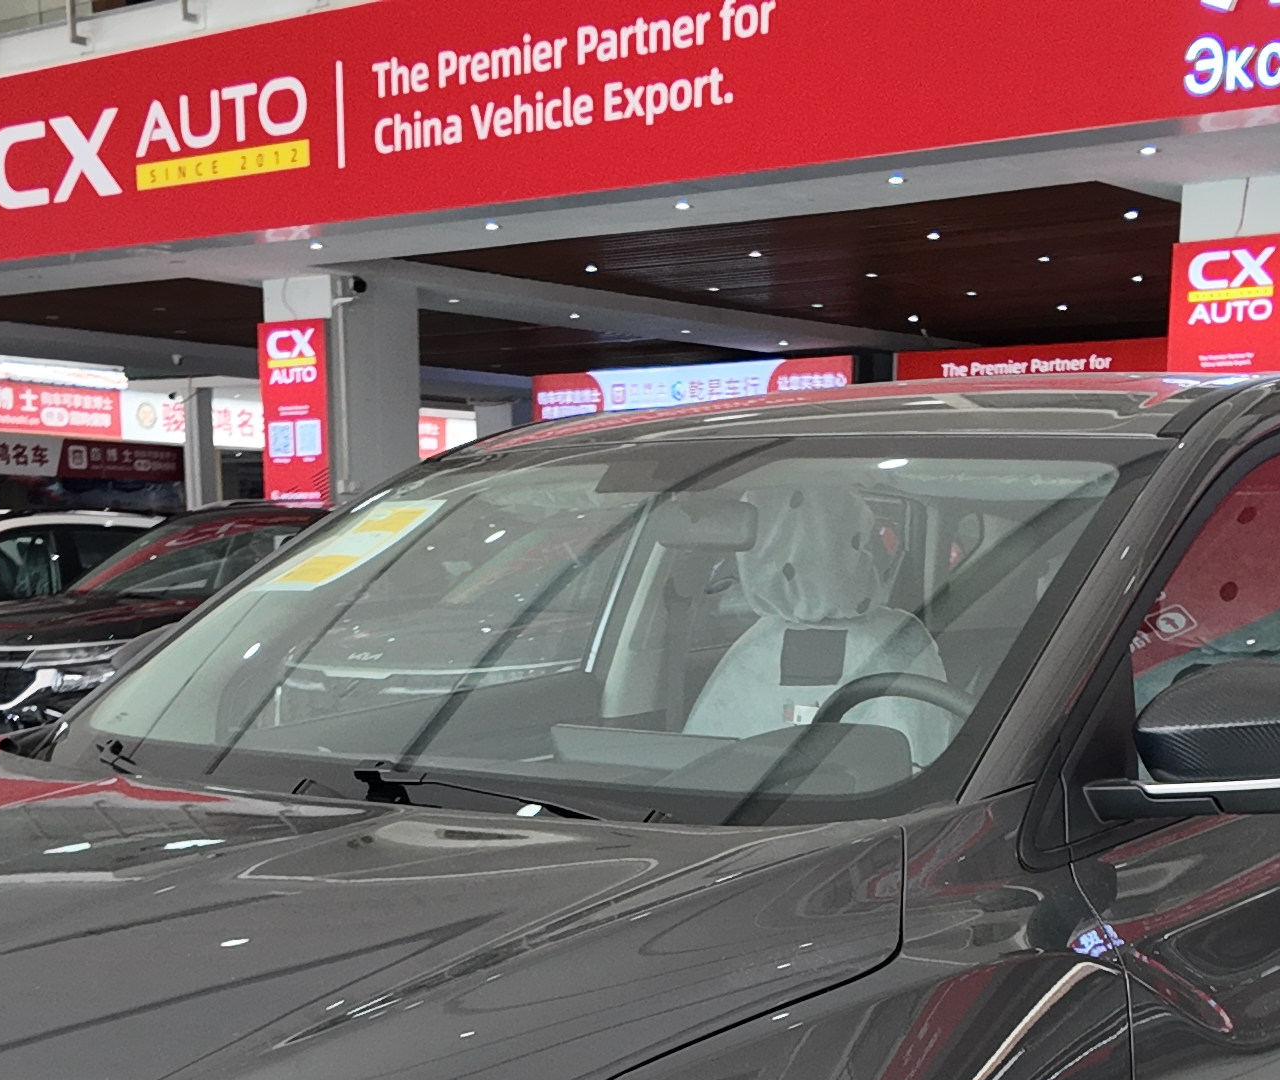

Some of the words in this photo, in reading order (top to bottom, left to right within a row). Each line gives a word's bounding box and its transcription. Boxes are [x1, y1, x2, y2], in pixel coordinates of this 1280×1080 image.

[372, 57, 429, 98] The
[438, 33, 568, 88] Premier
[577, 12, 711, 65] Partner
[720, 0, 777, 41] for
[136, 76, 308, 158] AUTO
[374, 111, 463, 154] China
[471, 86, 594, 141] Vehicle
[604, 67, 734, 125] Export.
[149, 160, 219, 184] SINCE
[240, 147, 299, 170] 2012
[1187, 246, 1276, 289] CX
[1187, 298, 1273, 326] AUTO
[267, 327, 316, 358] CX
[269, 366, 317, 385] AUTO
[941, 363, 968, 378] The
[970, 360, 1028, 376] Premier
[1030, 358, 1087, 373] Partner
[1089, 354, 1112, 370] for
